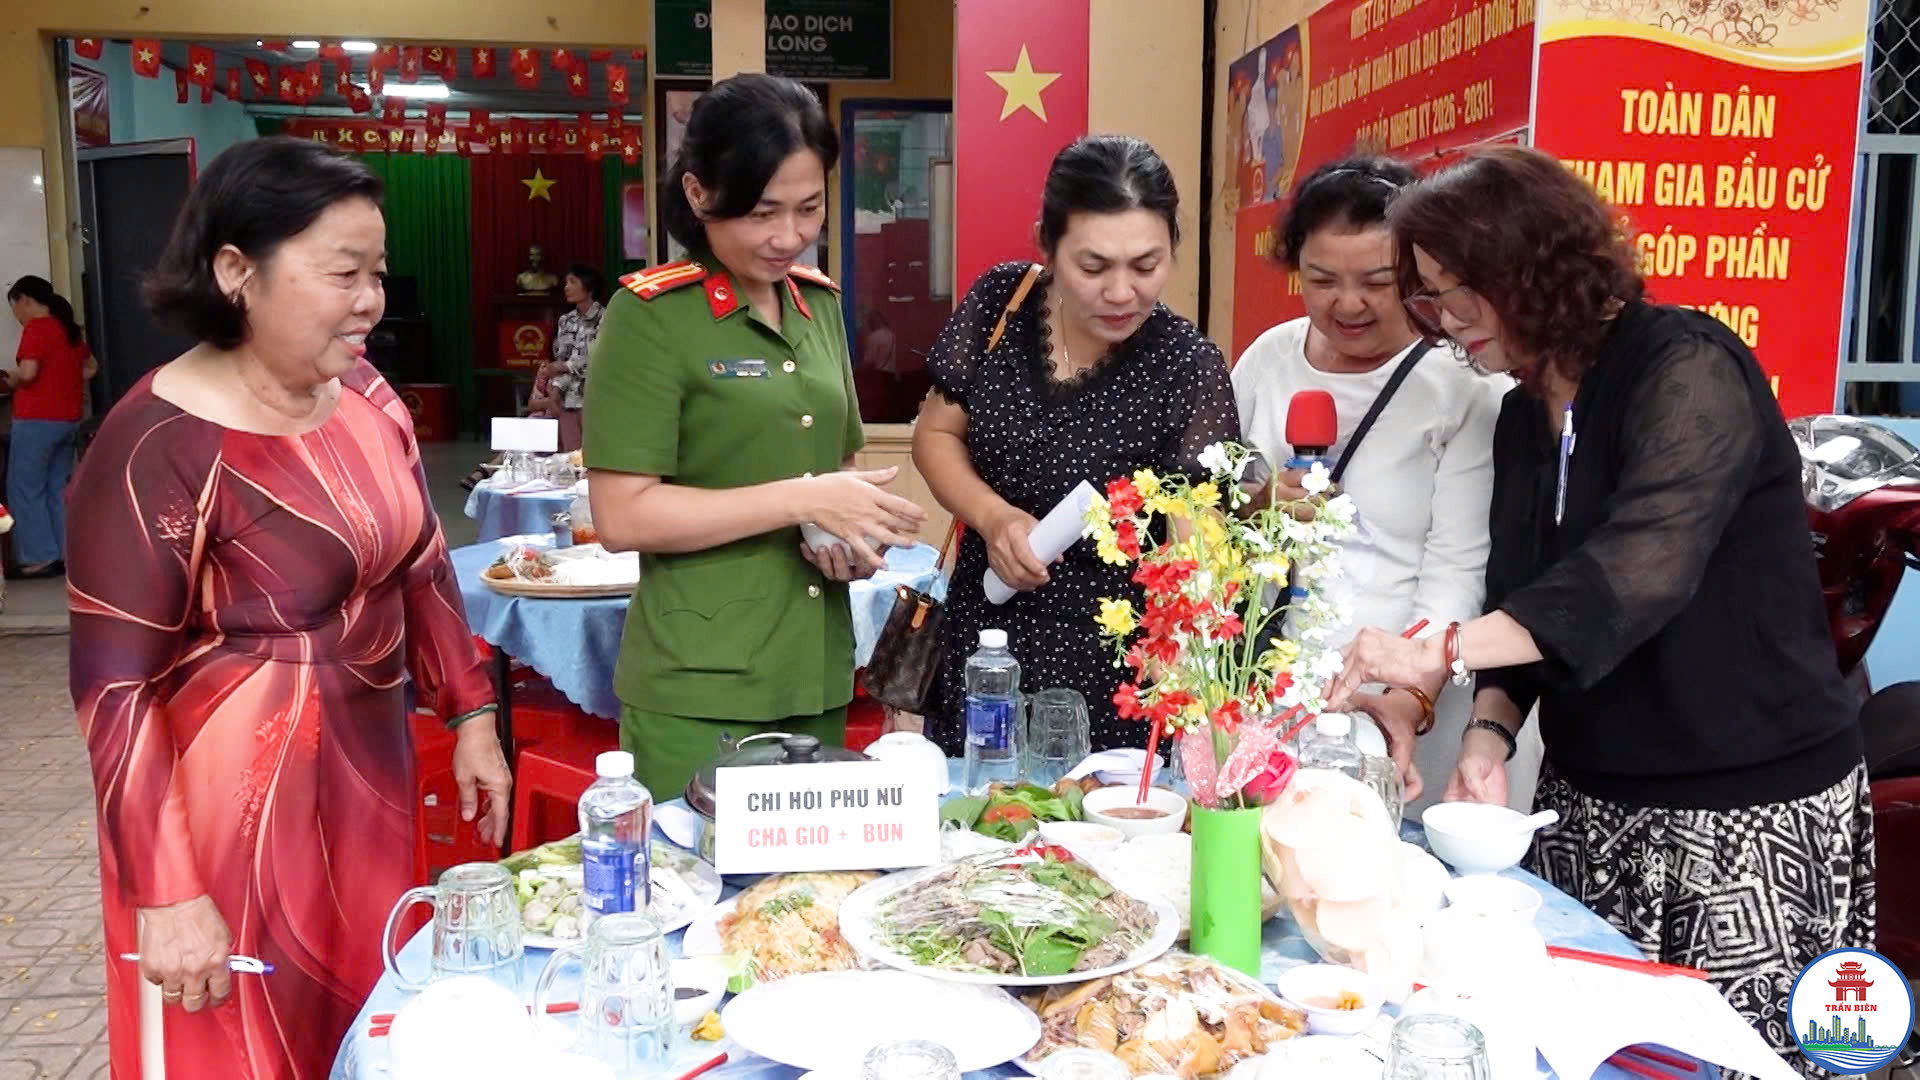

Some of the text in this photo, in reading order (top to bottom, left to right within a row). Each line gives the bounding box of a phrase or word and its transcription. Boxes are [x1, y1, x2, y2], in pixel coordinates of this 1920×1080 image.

[768, 35, 828, 52] LONG
[1440, 3, 1463, 62] BIỂU
[1464, 1, 1482, 56] HỘI
[1432, 92, 1455, 135] 2026
[1464, 77, 1494, 125] 2031!
[1621, 81, 1776, 138] TOÀN DÂN
[1654, 162, 1706, 207] GIA
[1714, 151, 1777, 209] BẦU
[1785, 153, 1832, 212] CỬ
[1635, 225, 1697, 277] GÓP
[1705, 221, 1790, 280] PHẦN
[748, 792, 781, 812] CHI
